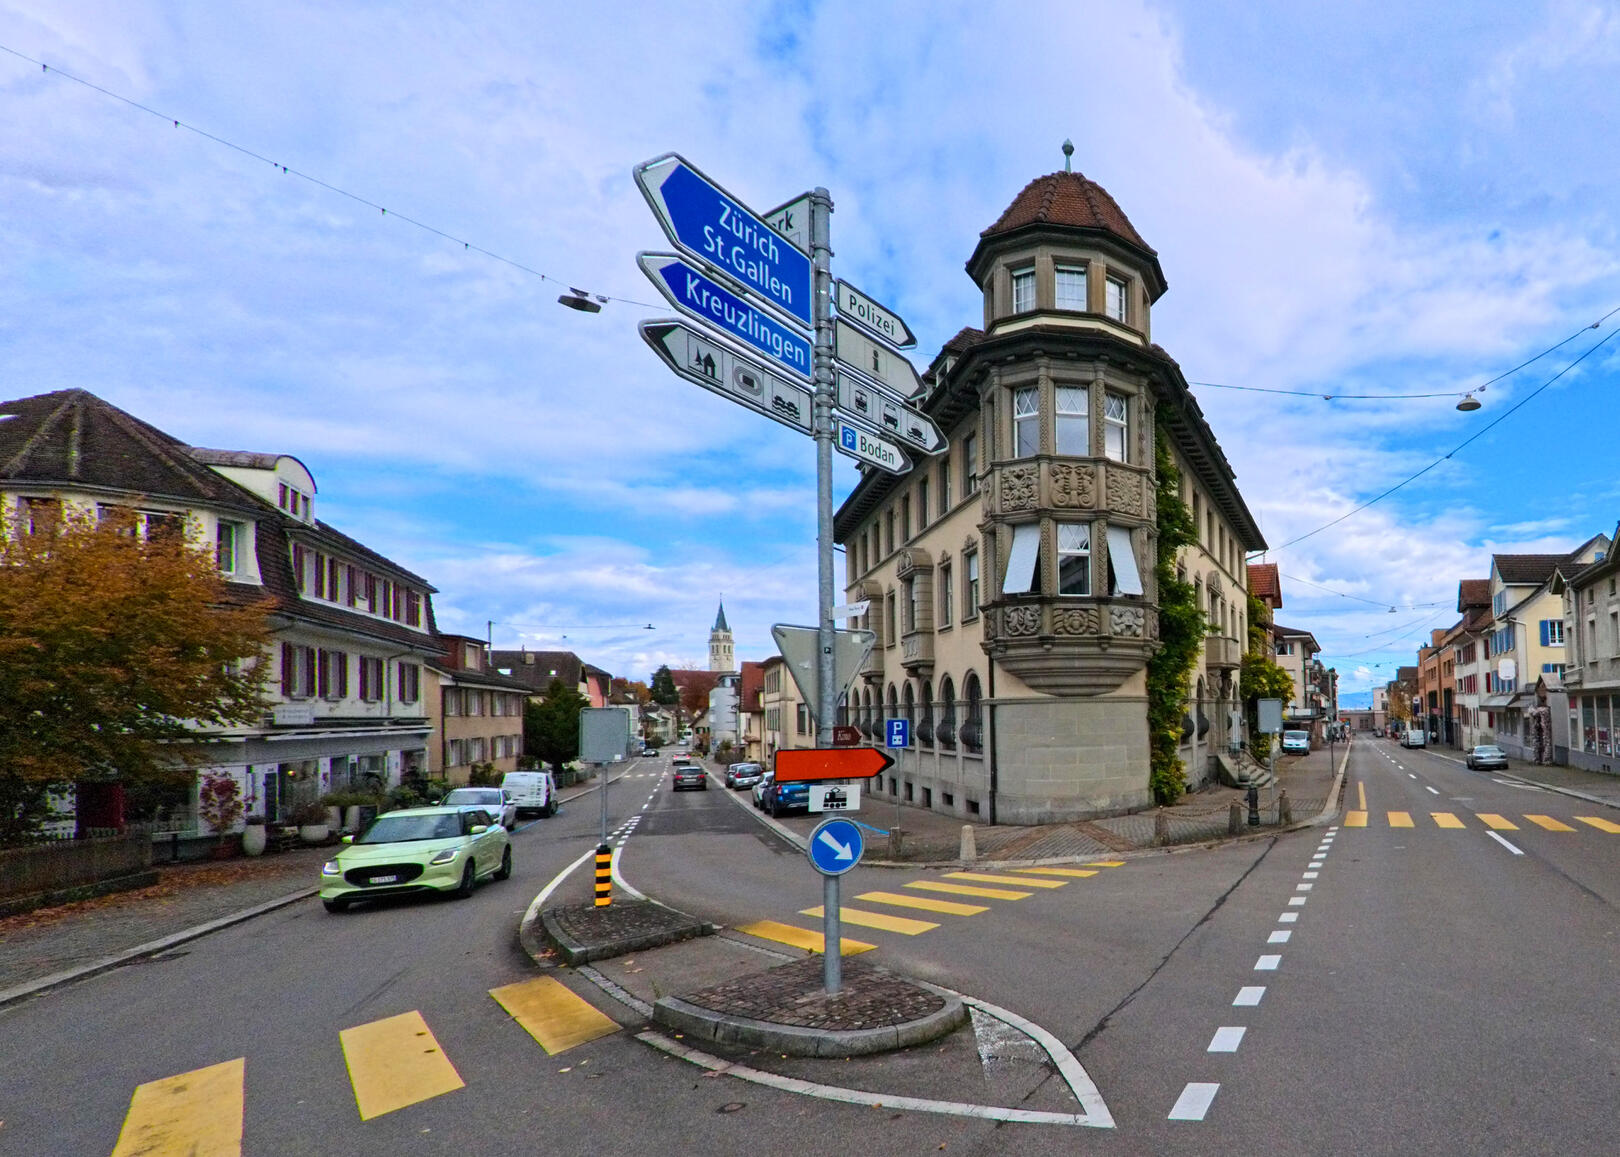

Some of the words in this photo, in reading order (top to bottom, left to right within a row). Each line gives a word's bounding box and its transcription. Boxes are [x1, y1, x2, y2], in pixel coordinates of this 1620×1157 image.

[719, 200, 779, 265] Zürich
[771, 210, 794, 232] rk
[686, 272, 805, 366] Kreuzlingen
[849, 294, 895, 336] Polizei
[846, 433, 853, 446] P
[860, 435, 894, 465] Bodan
[893, 721, 903, 735] P
